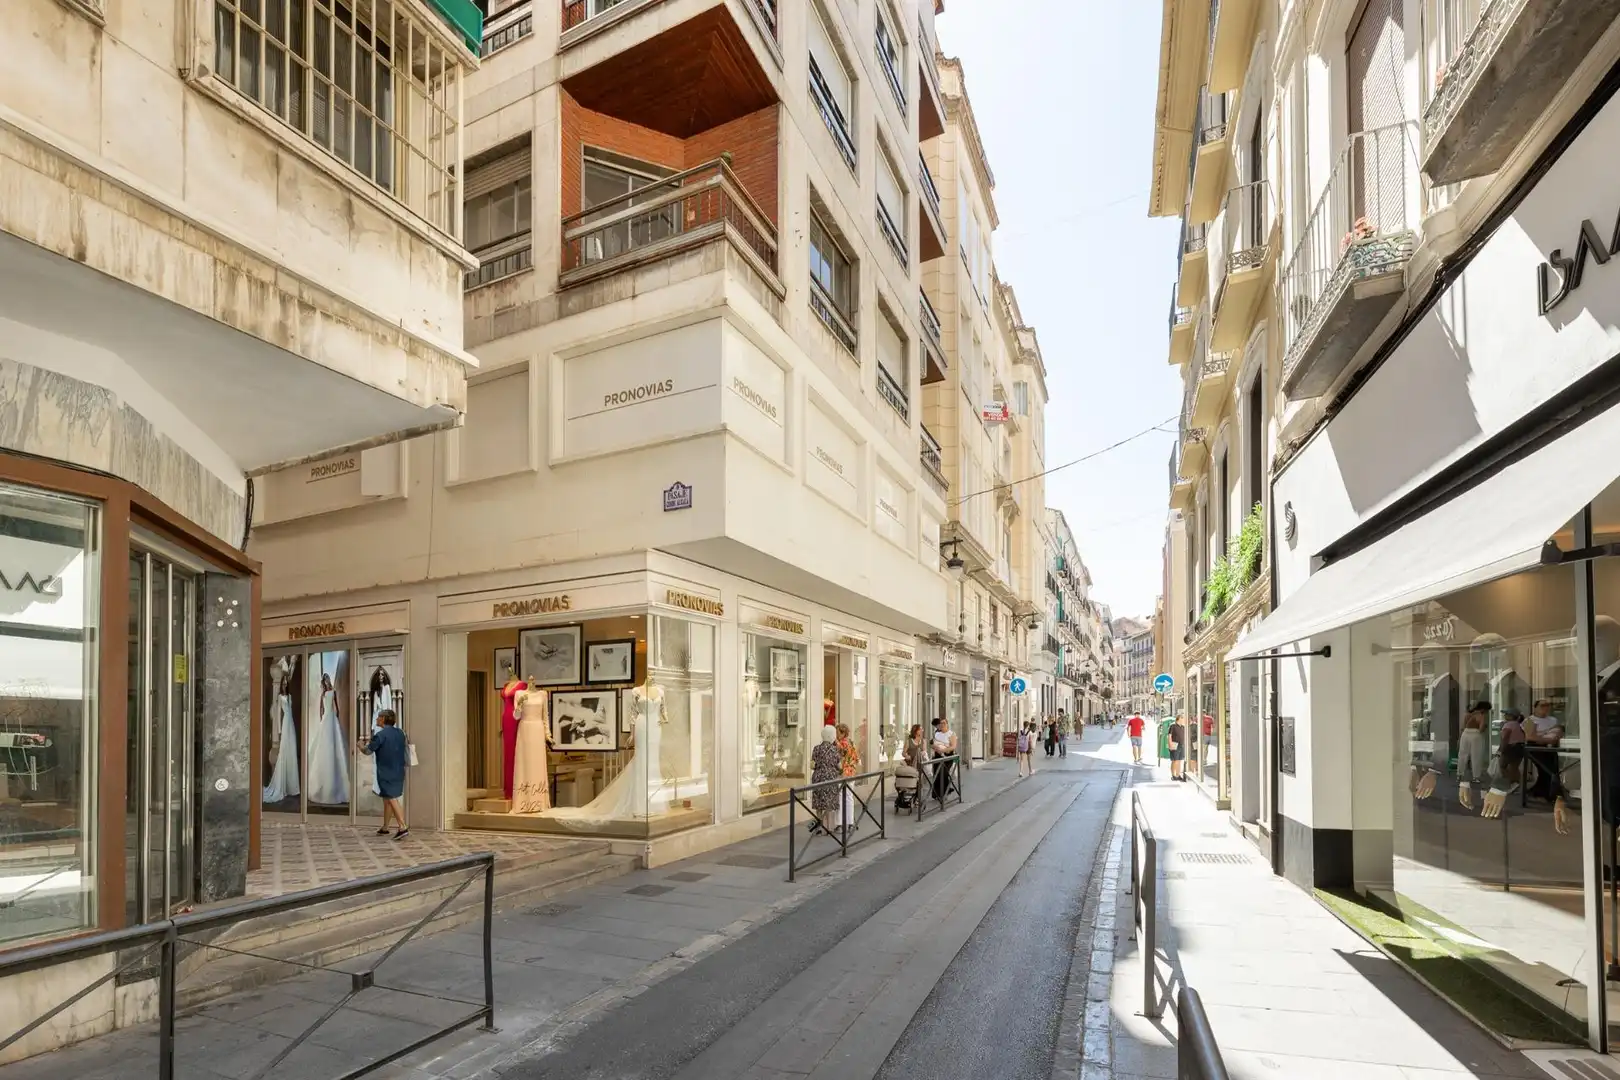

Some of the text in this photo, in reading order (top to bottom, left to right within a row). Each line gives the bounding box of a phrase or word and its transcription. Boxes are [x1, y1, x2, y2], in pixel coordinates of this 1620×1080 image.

[604, 379, 673, 406] PRONOVIAS
[733, 376, 777, 418] PRONOVIAS
[310, 458, 356, 478] PRONOVIAS
[492, 595, 571, 618] PRONOVIAS
[666, 590, 724, 616] PRONOVIAS
[289, 620, 346, 640] PRONOVIAS
[765, 615, 804, 635] PRONOVIAS
